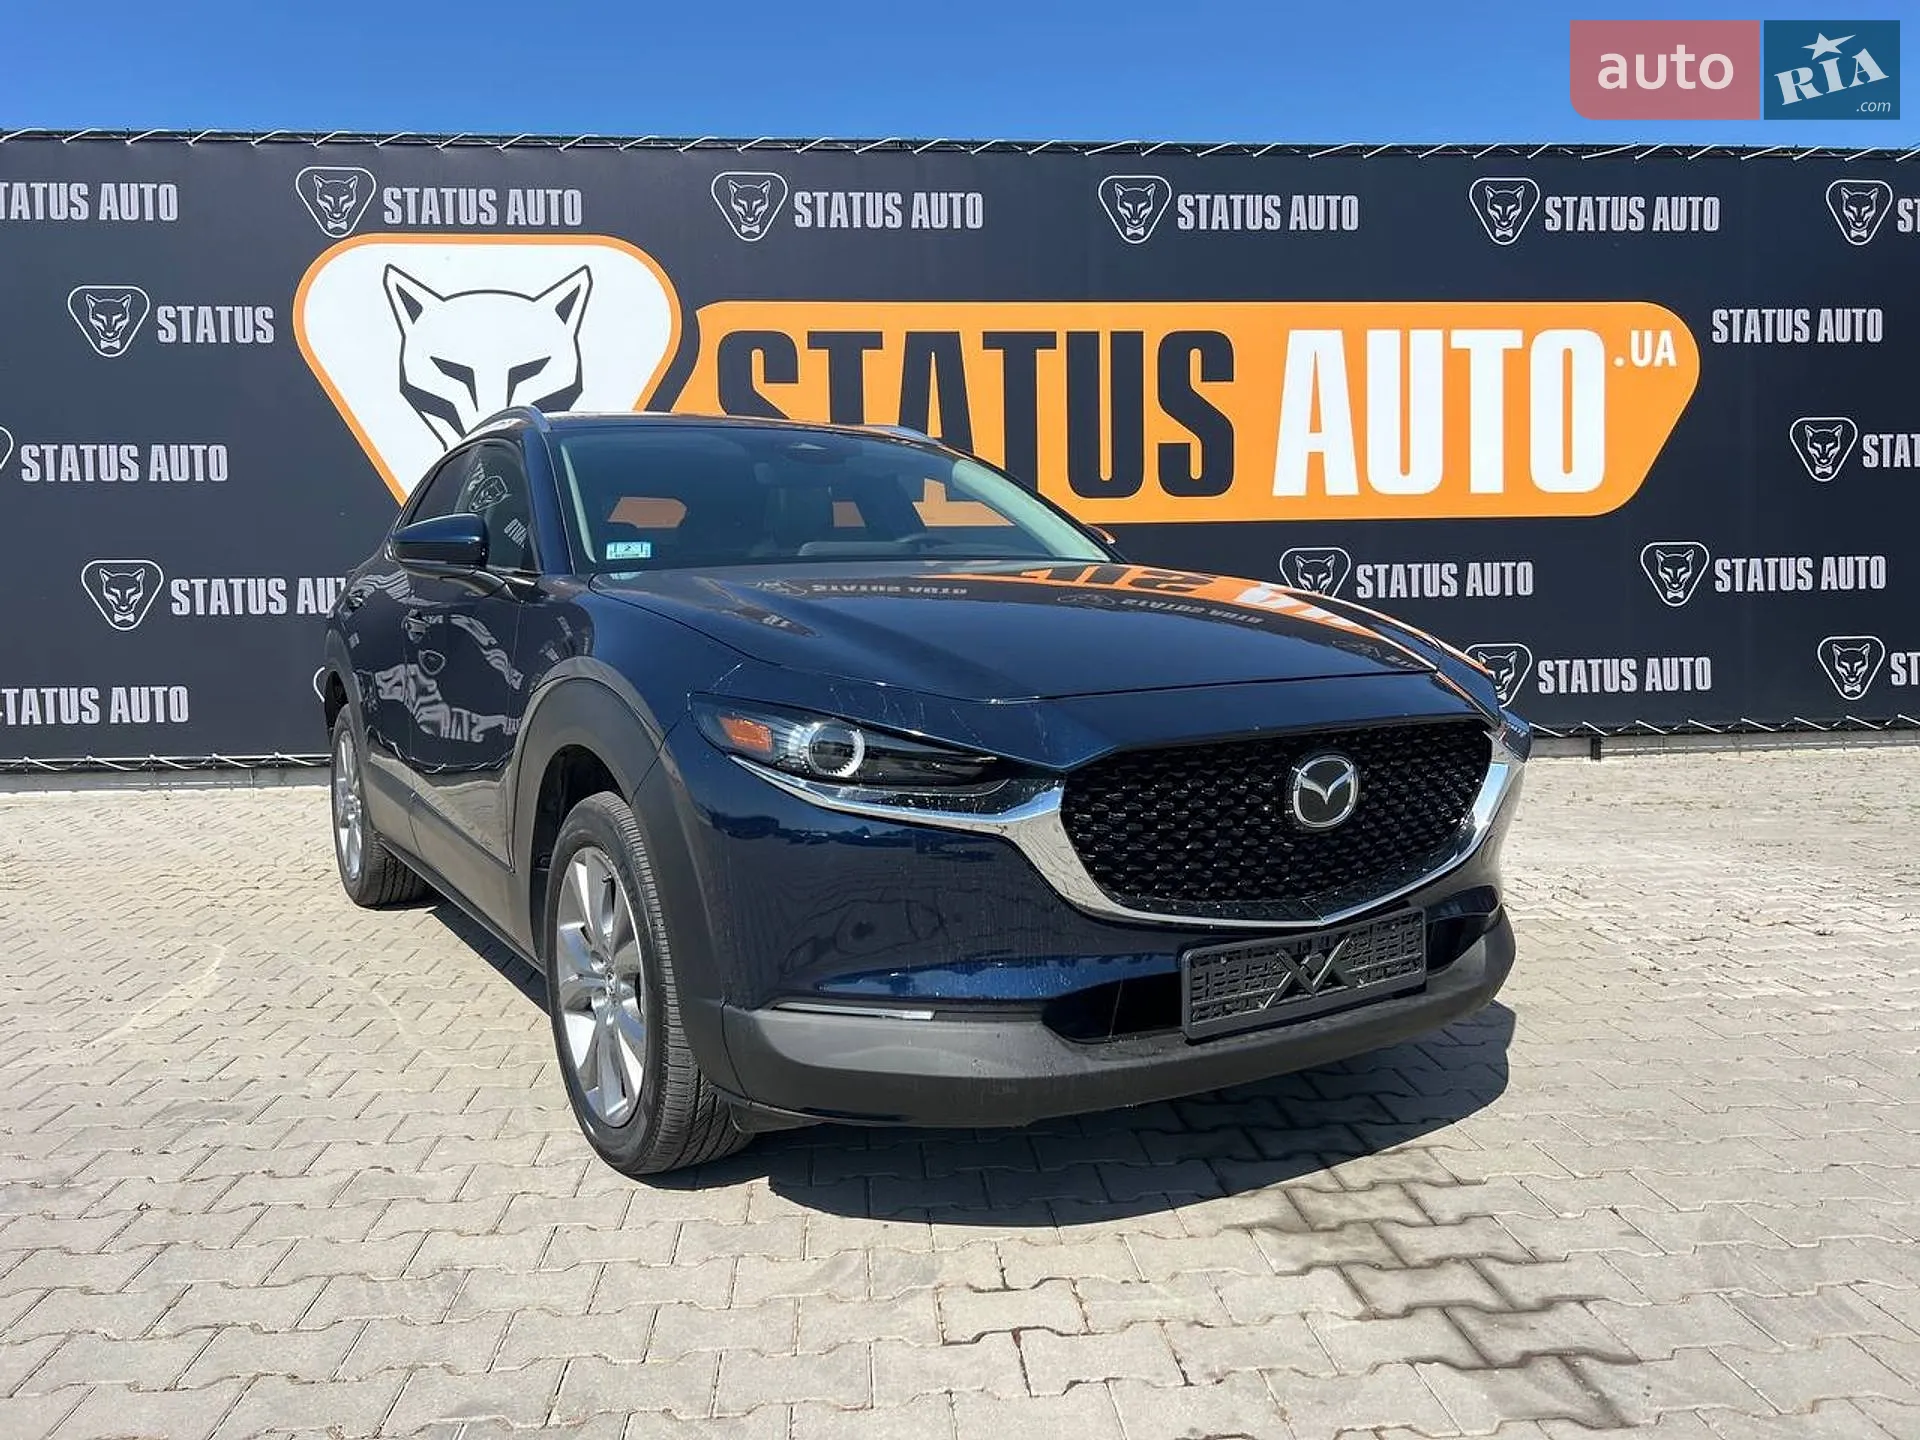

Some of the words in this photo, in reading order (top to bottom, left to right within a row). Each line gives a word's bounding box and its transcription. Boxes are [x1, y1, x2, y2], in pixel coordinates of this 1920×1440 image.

[99, 183, 178, 221] AUTO
[383, 188, 497, 225] STATUS
[507, 189, 582, 226] AUTO
[794, 192, 902, 229] STATUS
[911, 192, 983, 229] AUTO
[1178, 194, 1280, 231] STATUS
[1289, 195, 1359, 231] AUTO
[1545, 196, 1645, 232] STATUS
[1652, 197, 1721, 231] AUTO
[158, 306, 274, 343] STATUS
[1712, 309, 1810, 343] STATUS
[1817, 309, 1883, 343] AUTO
[1272, 329, 1605, 496] AUTO
[1613, 330, 1677, 367] .UA
[21, 445, 140, 482] STATUS
[149, 445, 228, 481] AUTO
[1356, 563, 1457, 598] STATUS
[1466, 562, 1533, 597] AUTO
[1715, 557, 1813, 592] STATUS
[1821, 556, 1887, 590] AUTO
[171, 578, 287, 615] STATUS
[1538, 659, 1637, 693] STATUS
[1645, 657, 1711, 692] AUTO
[0, 688, 100, 726] TATUS
[109, 686, 189, 723] AUTO
